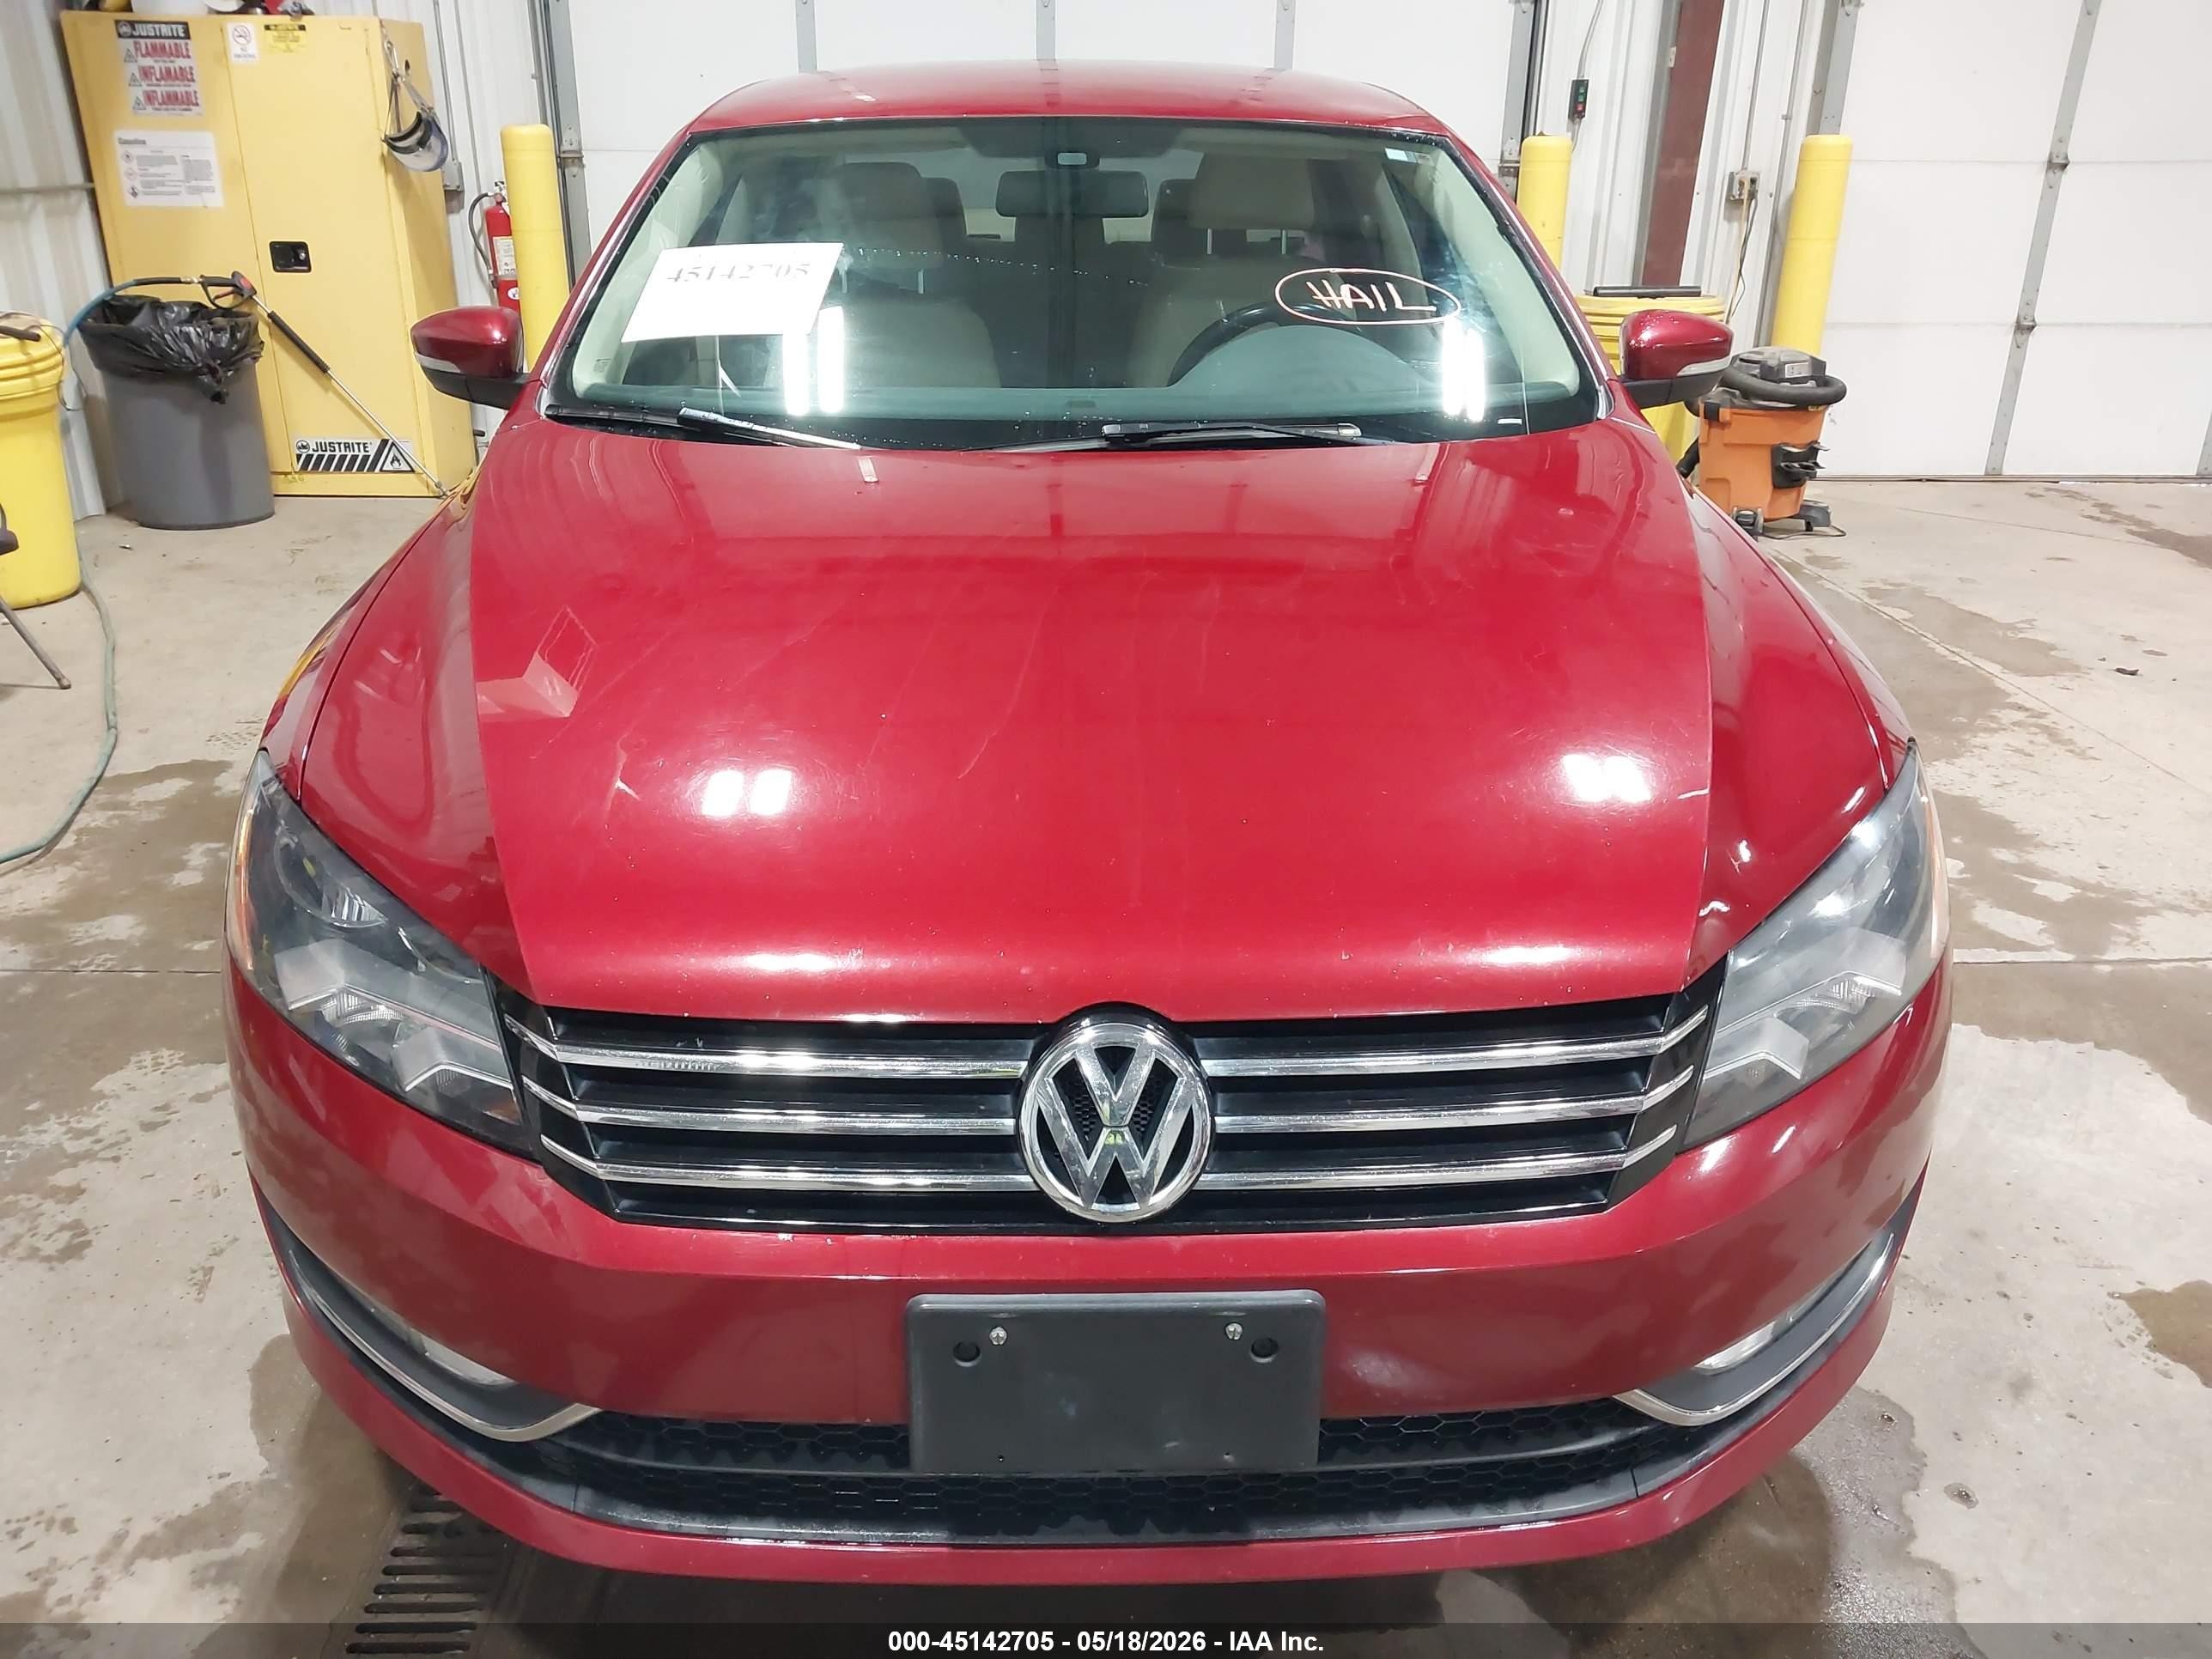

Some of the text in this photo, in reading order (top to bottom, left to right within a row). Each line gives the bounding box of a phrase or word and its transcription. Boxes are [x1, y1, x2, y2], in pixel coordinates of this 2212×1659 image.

[132, 23, 186, 37] JUSTRITE
[133, 40, 191, 59] FLAMMABLE
[1305, 279, 1437, 312] HAIL
[312, 441, 370, 453] JUSTRITE
